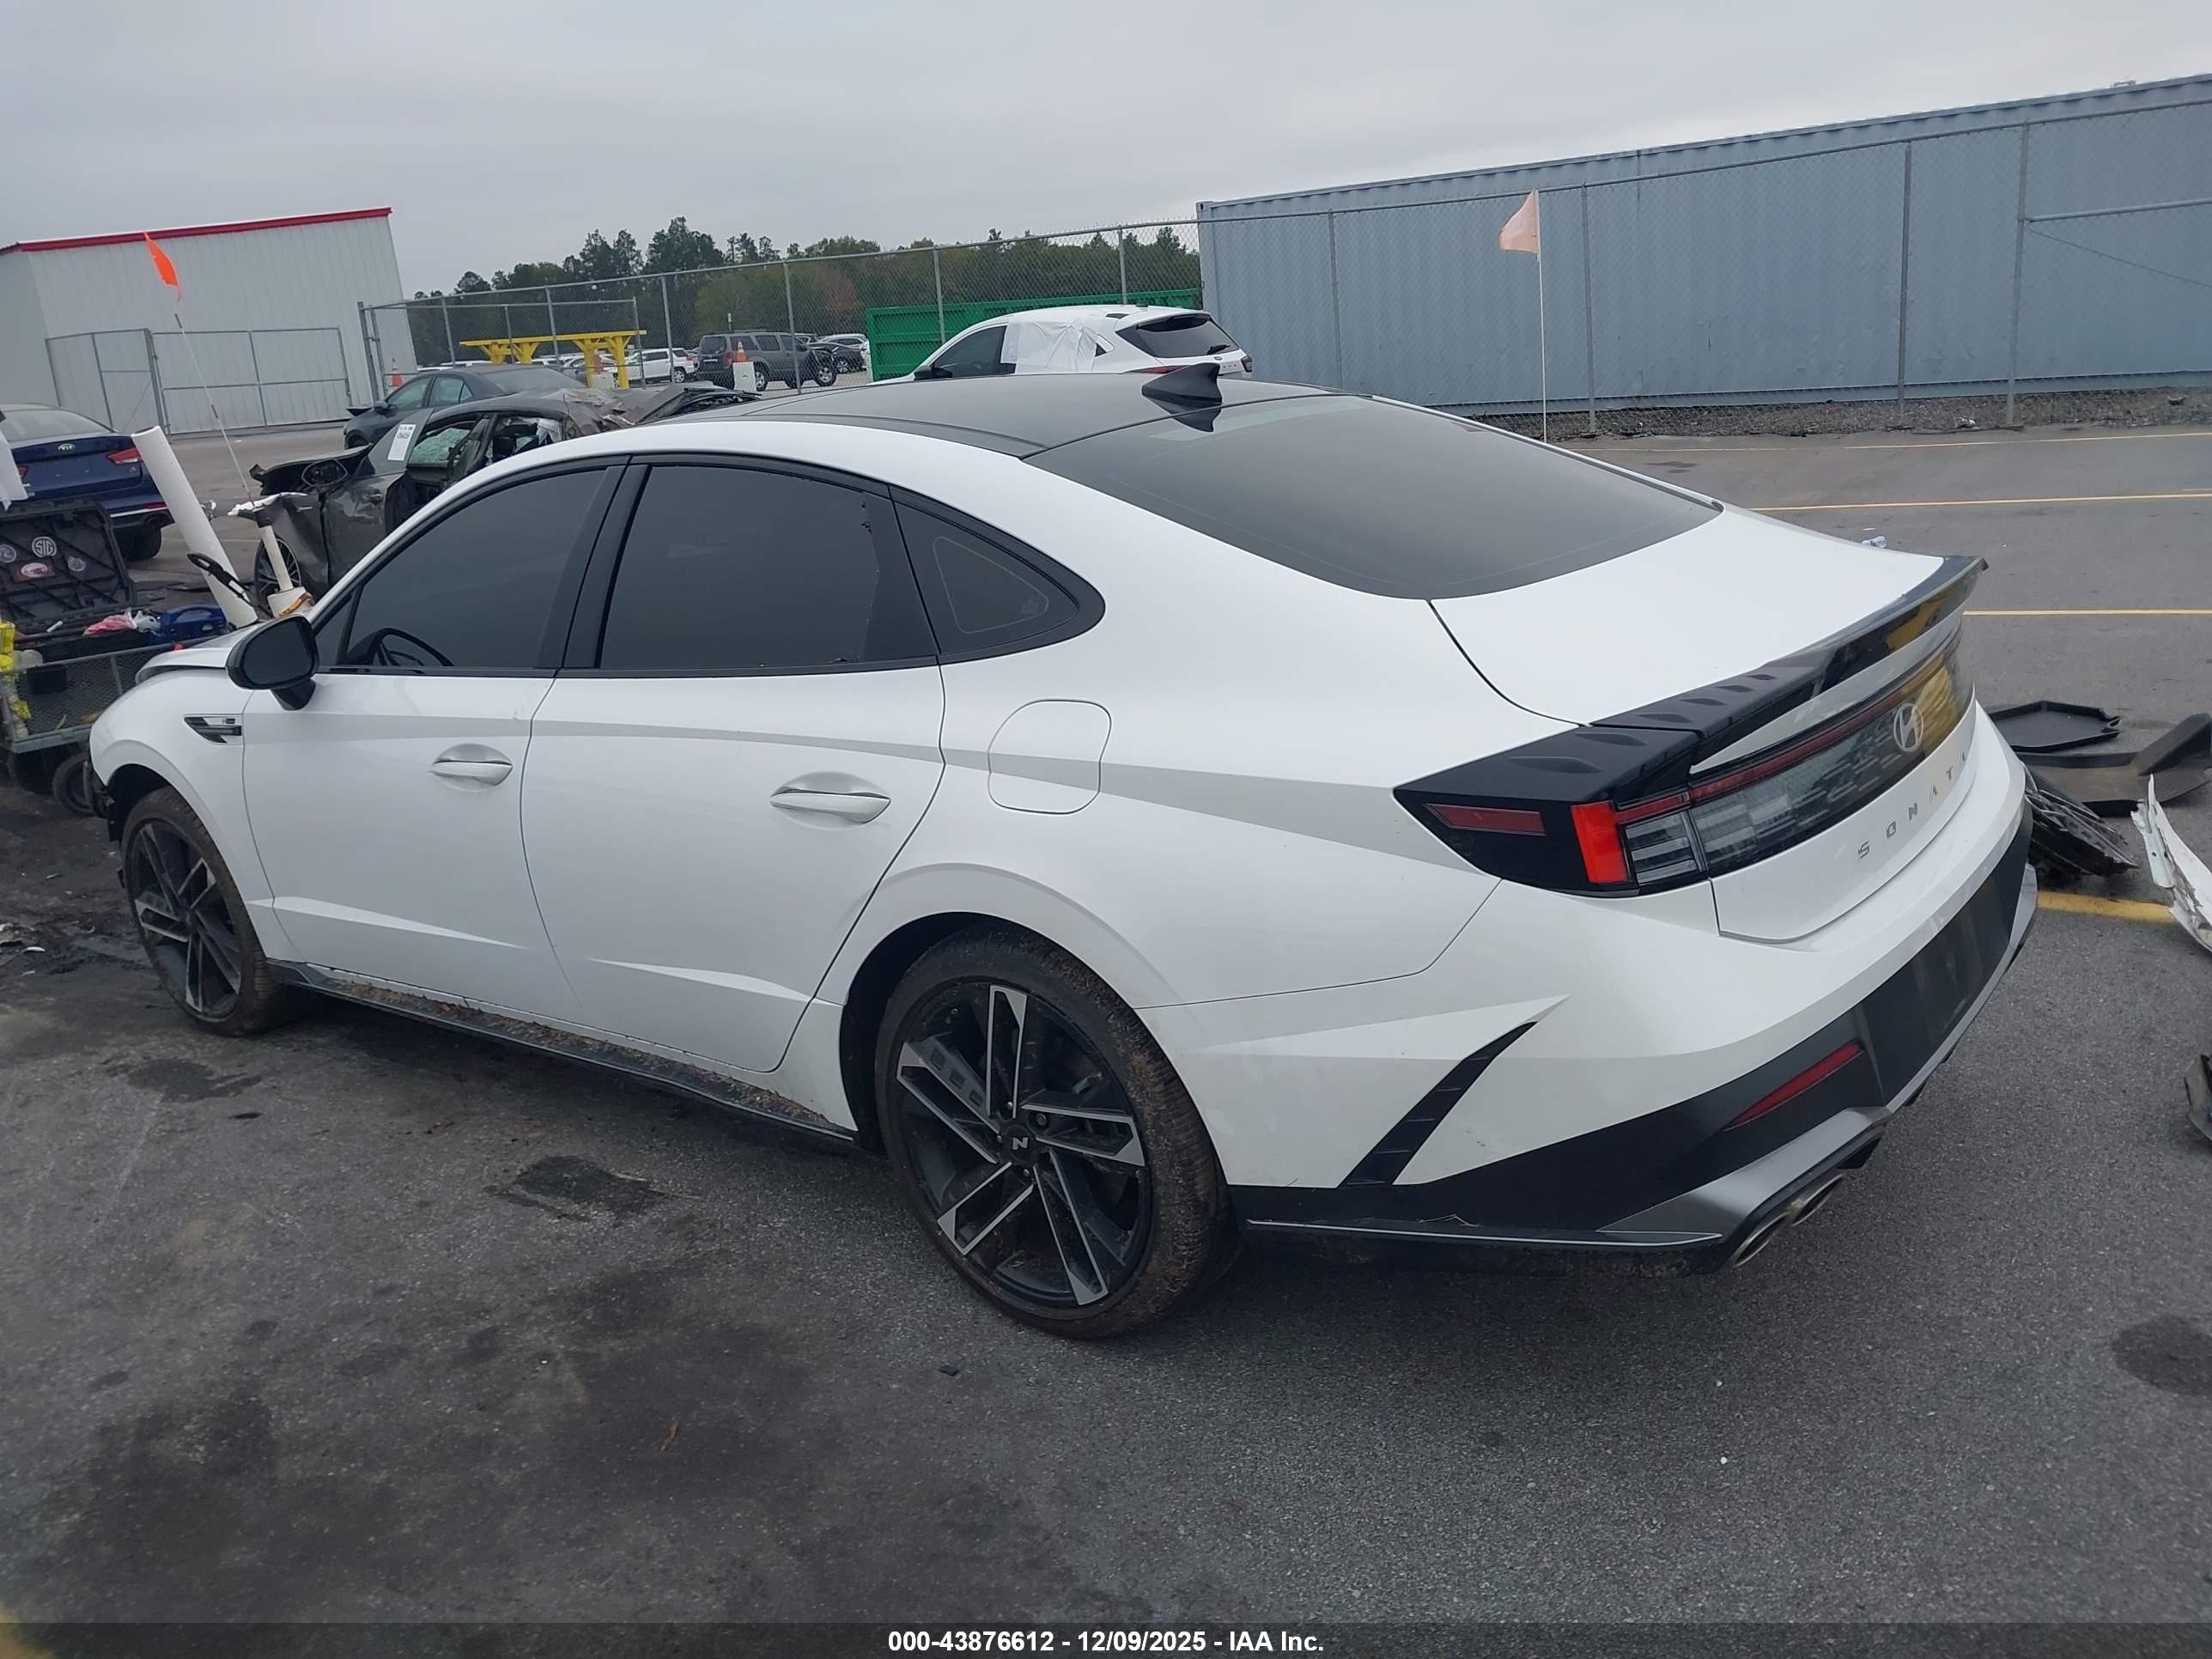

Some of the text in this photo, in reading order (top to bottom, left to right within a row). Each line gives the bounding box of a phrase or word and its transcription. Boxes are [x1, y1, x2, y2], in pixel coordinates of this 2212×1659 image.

[33, 538, 56, 557] SIG
[1857, 751, 1966, 859] SONATA
[1012, 1137, 1029, 1151] N
